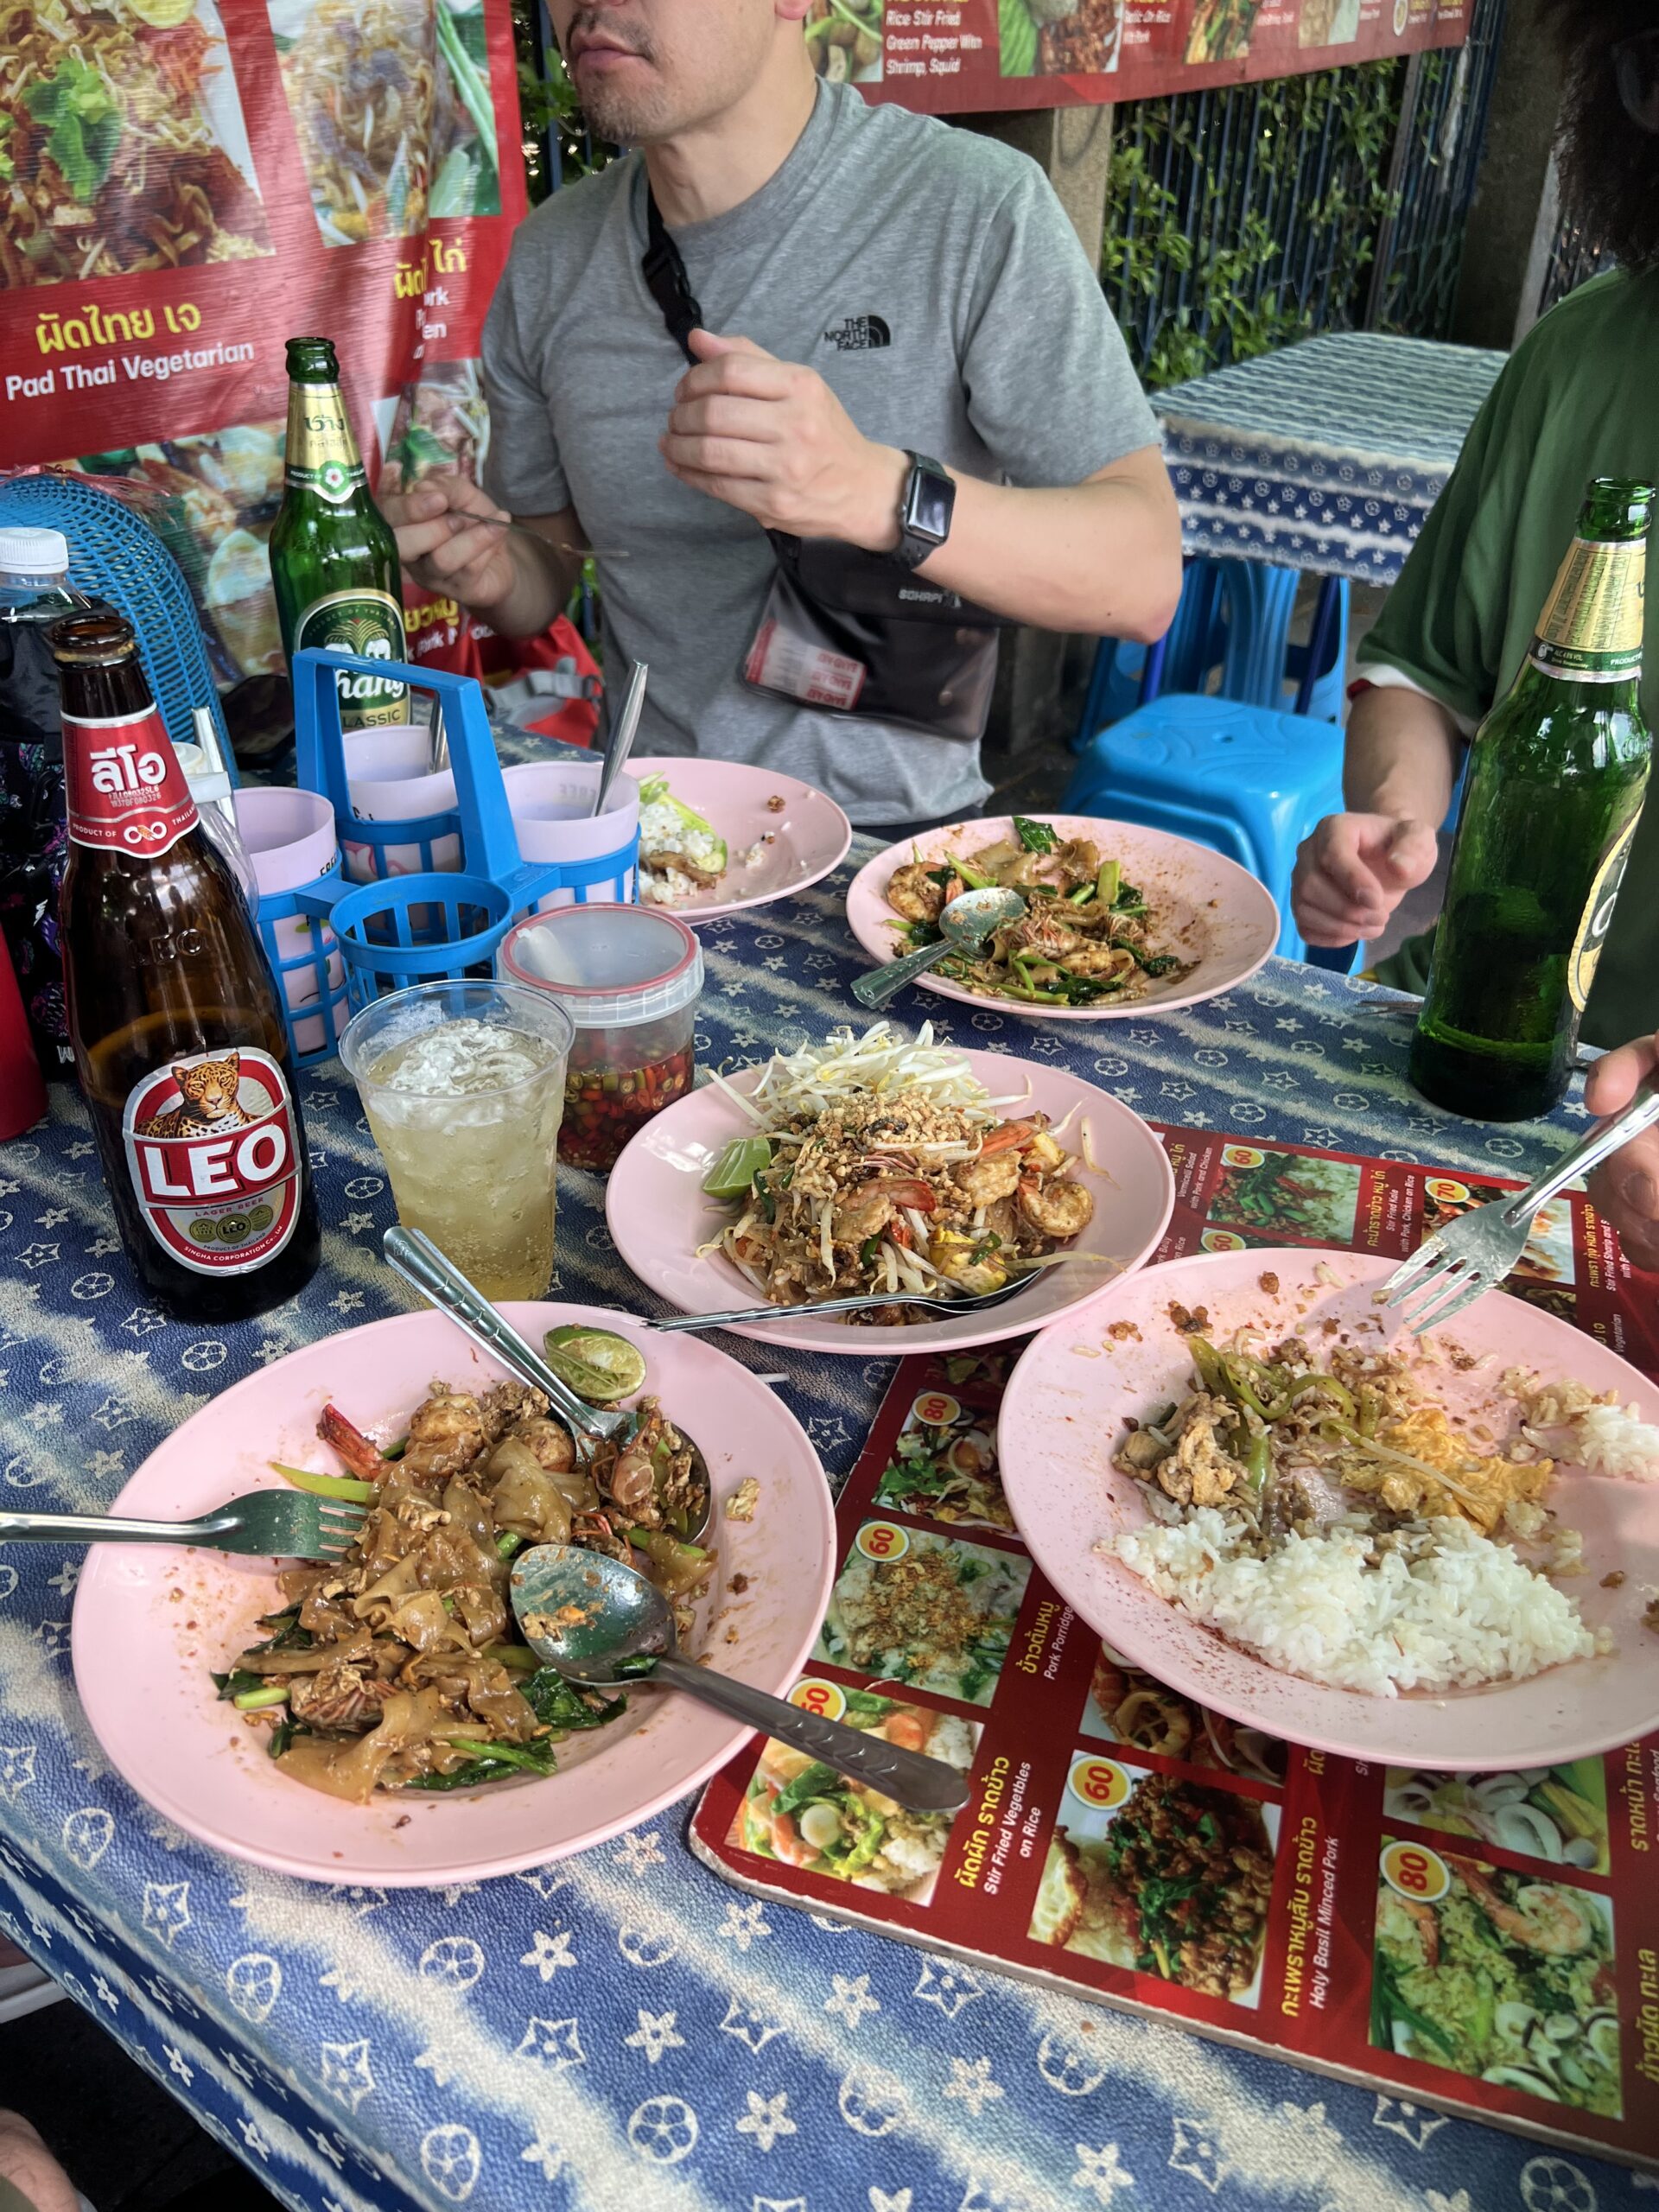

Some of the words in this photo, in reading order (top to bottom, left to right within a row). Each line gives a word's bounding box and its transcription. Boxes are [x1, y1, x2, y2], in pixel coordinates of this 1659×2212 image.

[886, 10, 912, 26] Rice
[913, 10, 934, 26] Stir
[935, 9, 961, 26] Fried
[887, 35, 920, 50] Green
[922, 34, 959, 54] Pepper
[929, 57, 961, 76] Squid
[35, 305, 156, 354] ผัดไทย
[164, 303, 201, 334] เจ
[845, 316, 867, 329] THE
[824, 329, 867, 342] NORTH
[837, 340, 867, 351] FACE
[5, 369, 55, 401] Pad
[60, 359, 117, 391] Thai
[122, 342, 254, 380] Vegetarian
[334, 669, 404, 699] hang
[343, 709, 401, 728] LASSIC
[90, 744, 166, 793] ลีโอ
[73, 823, 103, 837] PRODUCT
[143, 1124, 286, 1196] LEO
[1200, 1147, 1213, 1169] Chicken
[1235, 1150, 1252, 1164] 60
[1177, 1169, 1193, 1198] Vermicelli
[1185, 1152, 1198, 1169] Salad
[1404, 1175, 1414, 1189] Rice
[1192, 1181, 1203, 1196] Pork
[1389, 1189, 1399, 1203] Kale
[1437, 1183, 1455, 1198] 70
[194, 1207, 232, 1217] LAGER
[238, 1197, 264, 1210] BEER
[1191, 1196, 1199, 1209] with
[1388, 1205, 1398, 1219] Fried
[1402, 1199, 1414, 1221] Chicken
[222, 1223, 246, 1235] LEO
[1386, 1219, 1395, 1231] Stir
[1603, 1225, 1612, 1238] and
[184, 1245, 211, 1261] SINGHA
[213, 1244, 266, 1262] CORPORATION
[1160, 1236, 1172, 1253] Belly
[1175, 1236, 1186, 1251] Rice
[1213, 1235, 1232, 1252] 60
[1157, 1252, 1166, 1264] ork
[1605, 1261, 1616, 1280] Fried
[1606, 1280, 1617, 1292] Stir
[1613, 1313, 1626, 1353] Vegetarian
[924, 1398, 947, 1420] 80
[869, 1529, 894, 1554] 60
[1016, 1601, 1061, 1675] ข้าวต้มหมู
[1051, 1605, 1074, 1652] Porridge
[1044, 1654, 1061, 1681] Pork
[1084, 1766, 1113, 1800] 60
[1003, 1762, 1032, 1827] Vegetbles
[954, 1829, 990, 1889] ผัดผัก
[978, 1757, 1010, 1826] ราดข้าว
[1023, 1807, 1042, 1837] Rice
[1619, 1779, 1649, 1852] ราดหน้า
[992, 1830, 1013, 1866] Fried
[1020, 1840, 1033, 1858] on
[1293, 1816, 1318, 1885] ราดข้าว
[1322, 1835, 1338, 1867] Pork
[983, 1868, 1003, 1895] Stir
[1399, 1853, 1427, 1891] 80
[1318, 1871, 1336, 1925] Minced
[1281, 1891, 1314, 2018] กะเพราหมูสับ
[1313, 1929, 1331, 1968] Basil
[1310, 1971, 1330, 2009] Holy
